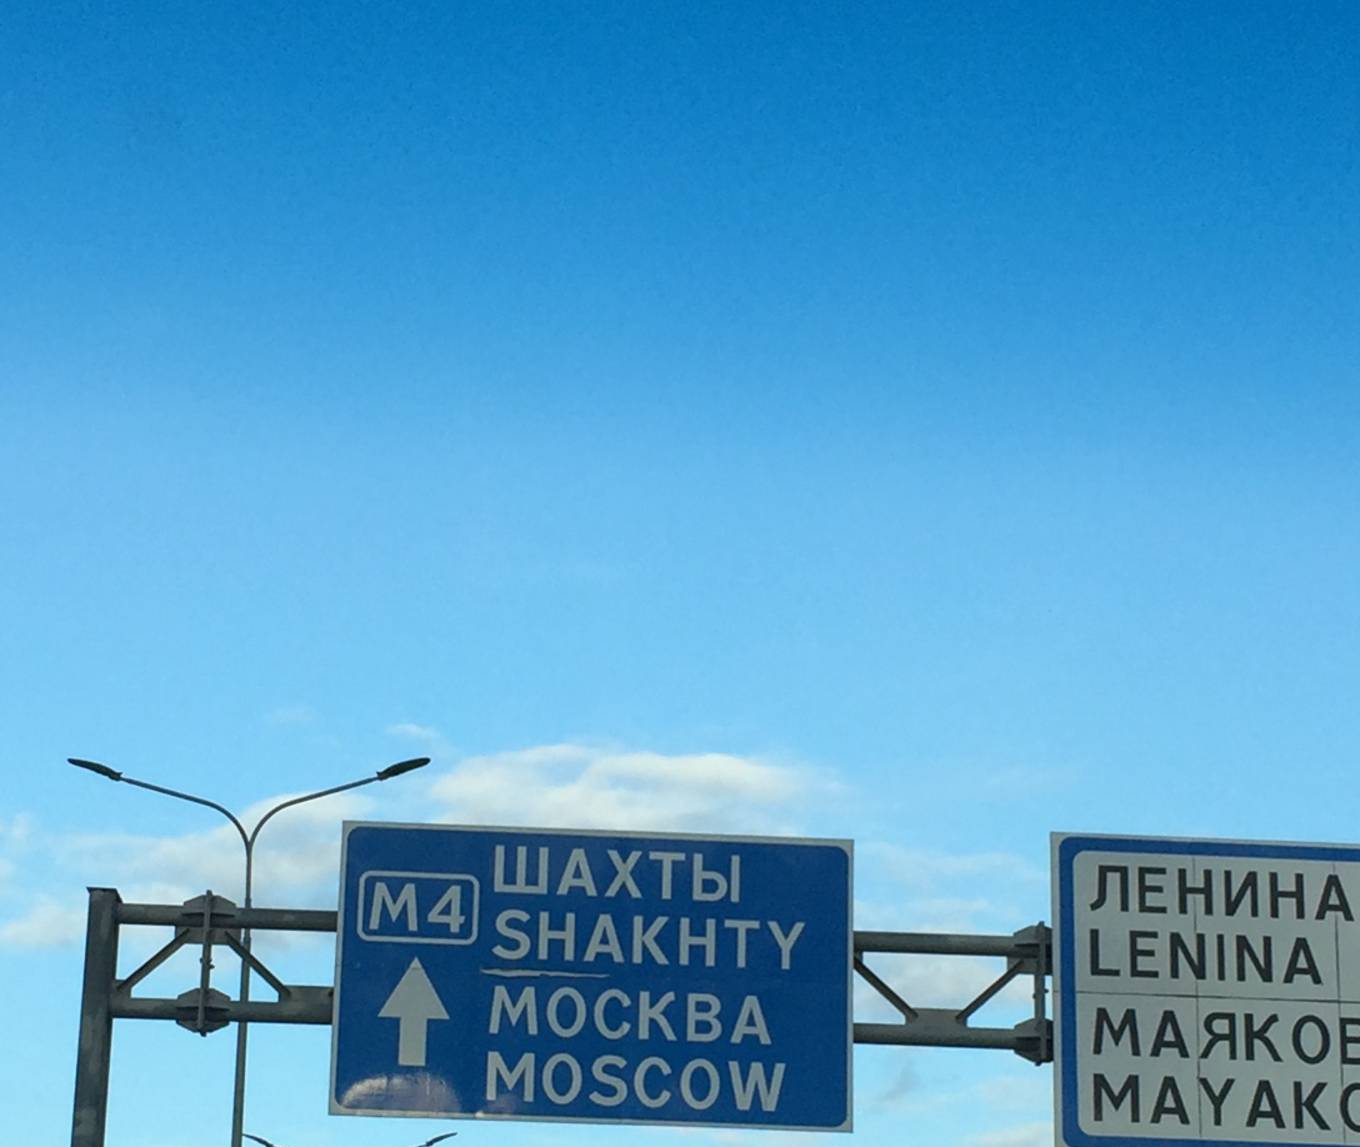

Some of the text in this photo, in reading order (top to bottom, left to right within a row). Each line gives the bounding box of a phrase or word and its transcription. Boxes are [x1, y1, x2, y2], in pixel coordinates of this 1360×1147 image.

[495, 846, 739, 901] ШАХТЫ
[1090, 865, 1354, 921] ЛЕНИНА
[493, 910, 804, 968] SHAKHTY
[1090, 929, 1322, 984] LENINA
[490, 986, 770, 1043] МОСКВА
[487, 1052, 784, 1111] MOSCOW
